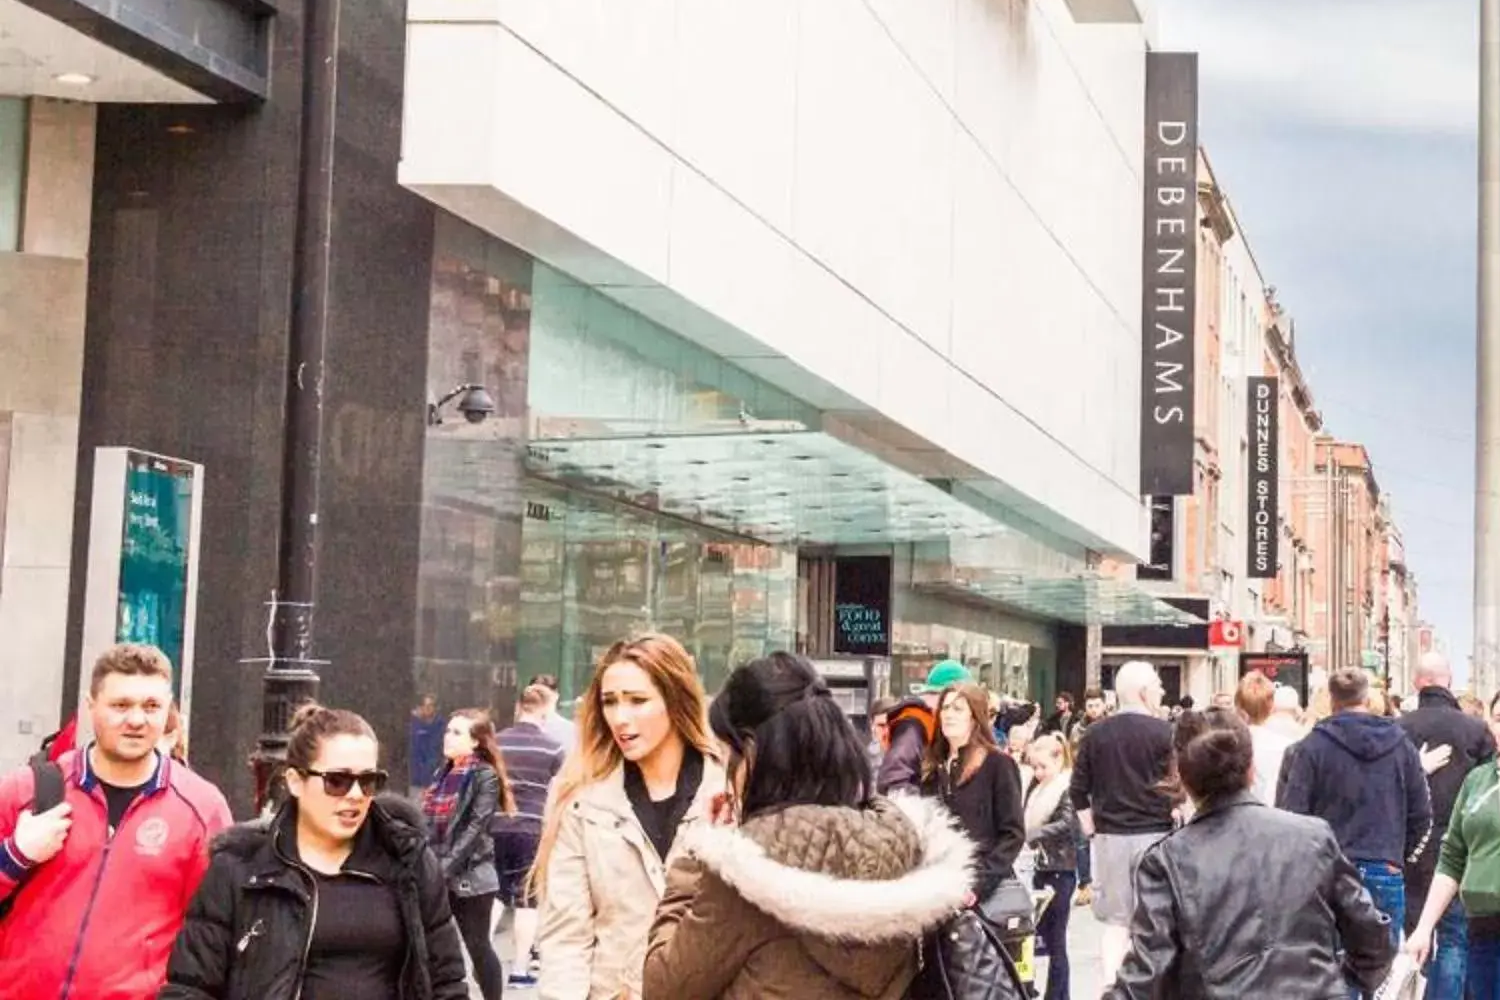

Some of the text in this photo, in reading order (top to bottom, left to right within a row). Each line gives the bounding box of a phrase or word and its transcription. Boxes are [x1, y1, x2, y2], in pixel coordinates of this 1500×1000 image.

[1153, 120, 1187, 425] DEBENHAMS
[1255, 384, 1271, 571] DUNNES STORES
